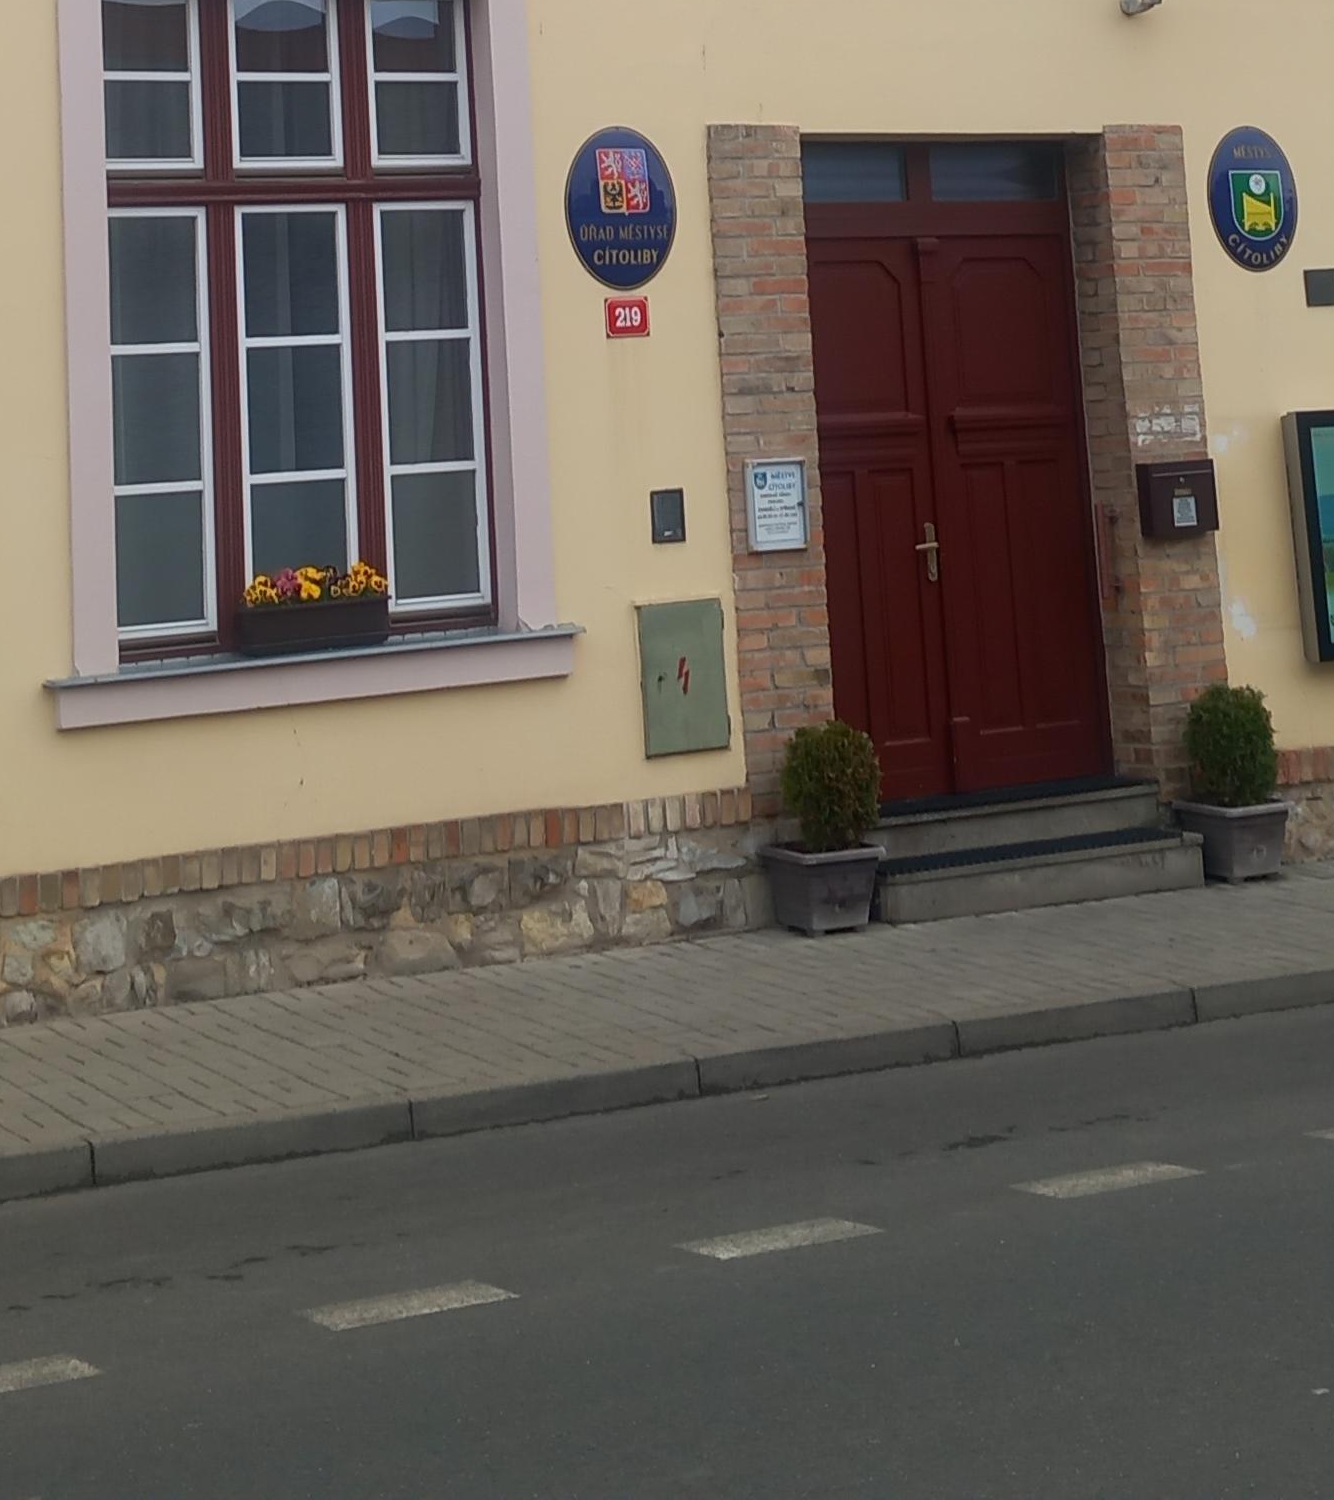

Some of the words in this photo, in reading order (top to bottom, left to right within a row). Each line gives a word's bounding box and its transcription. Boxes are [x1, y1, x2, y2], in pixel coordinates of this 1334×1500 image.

[1232, 145, 1273, 159] MĚSTYS
[579, 223, 615, 242] ÚŘAD
[593, 246, 660, 266] CÍTOLIBY
[1227, 233, 1289, 265] CÍTOLIBY
[614, 306, 642, 328] 219
